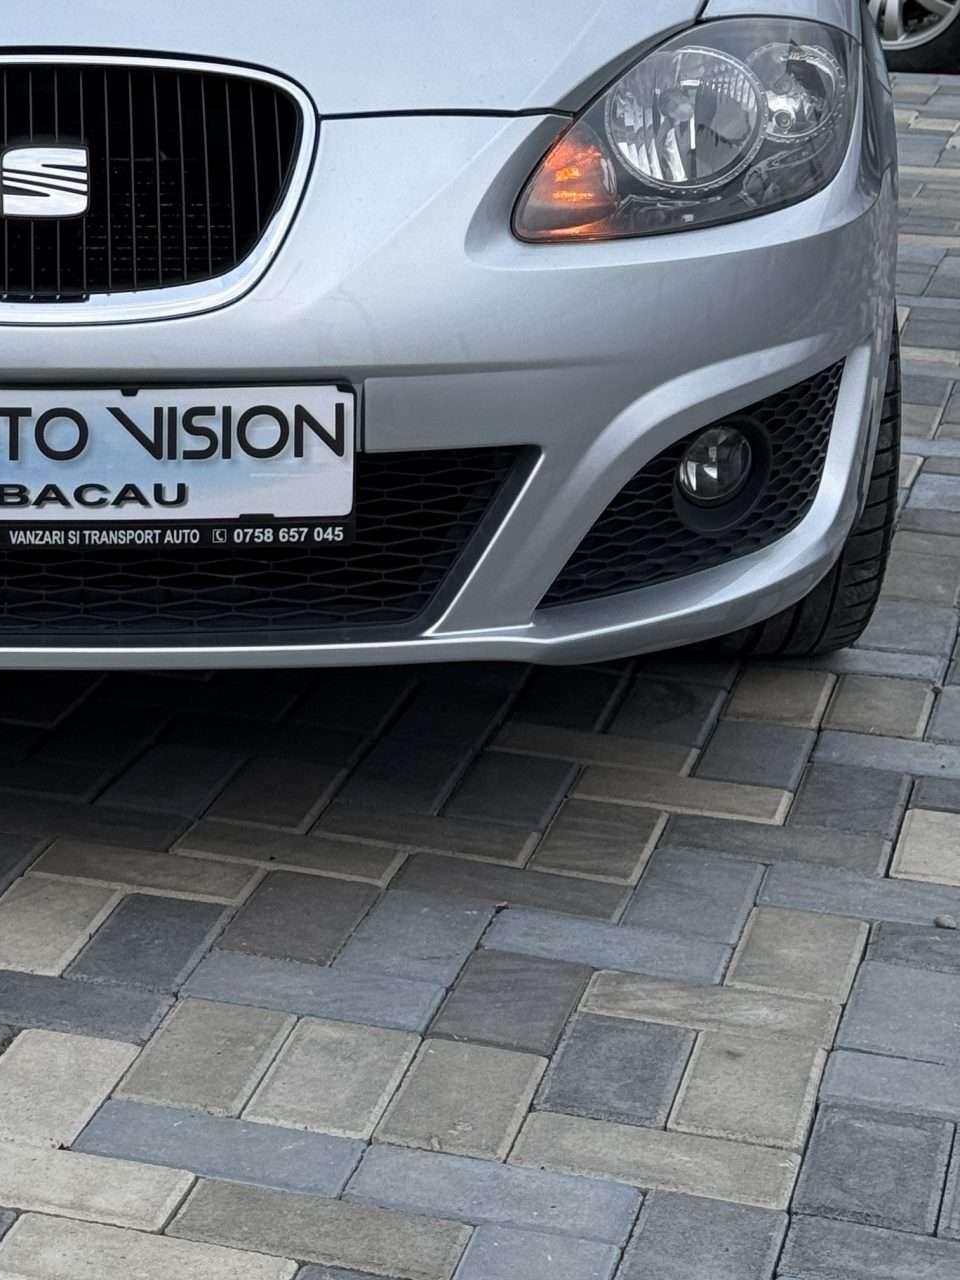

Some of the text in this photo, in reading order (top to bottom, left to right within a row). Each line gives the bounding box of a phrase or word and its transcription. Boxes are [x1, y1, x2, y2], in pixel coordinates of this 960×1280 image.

[106, 402, 345, 461] VISION
[9, 530, 65, 545] VANZARI
[67, 530, 81, 545] SI
[83, 529, 162, 545] TRANSPORT
[163, 529, 200, 544] AUTO
[233, 527, 274, 543] 0758
[278, 526, 307, 542] 657
[313, 526, 344, 542] 045
